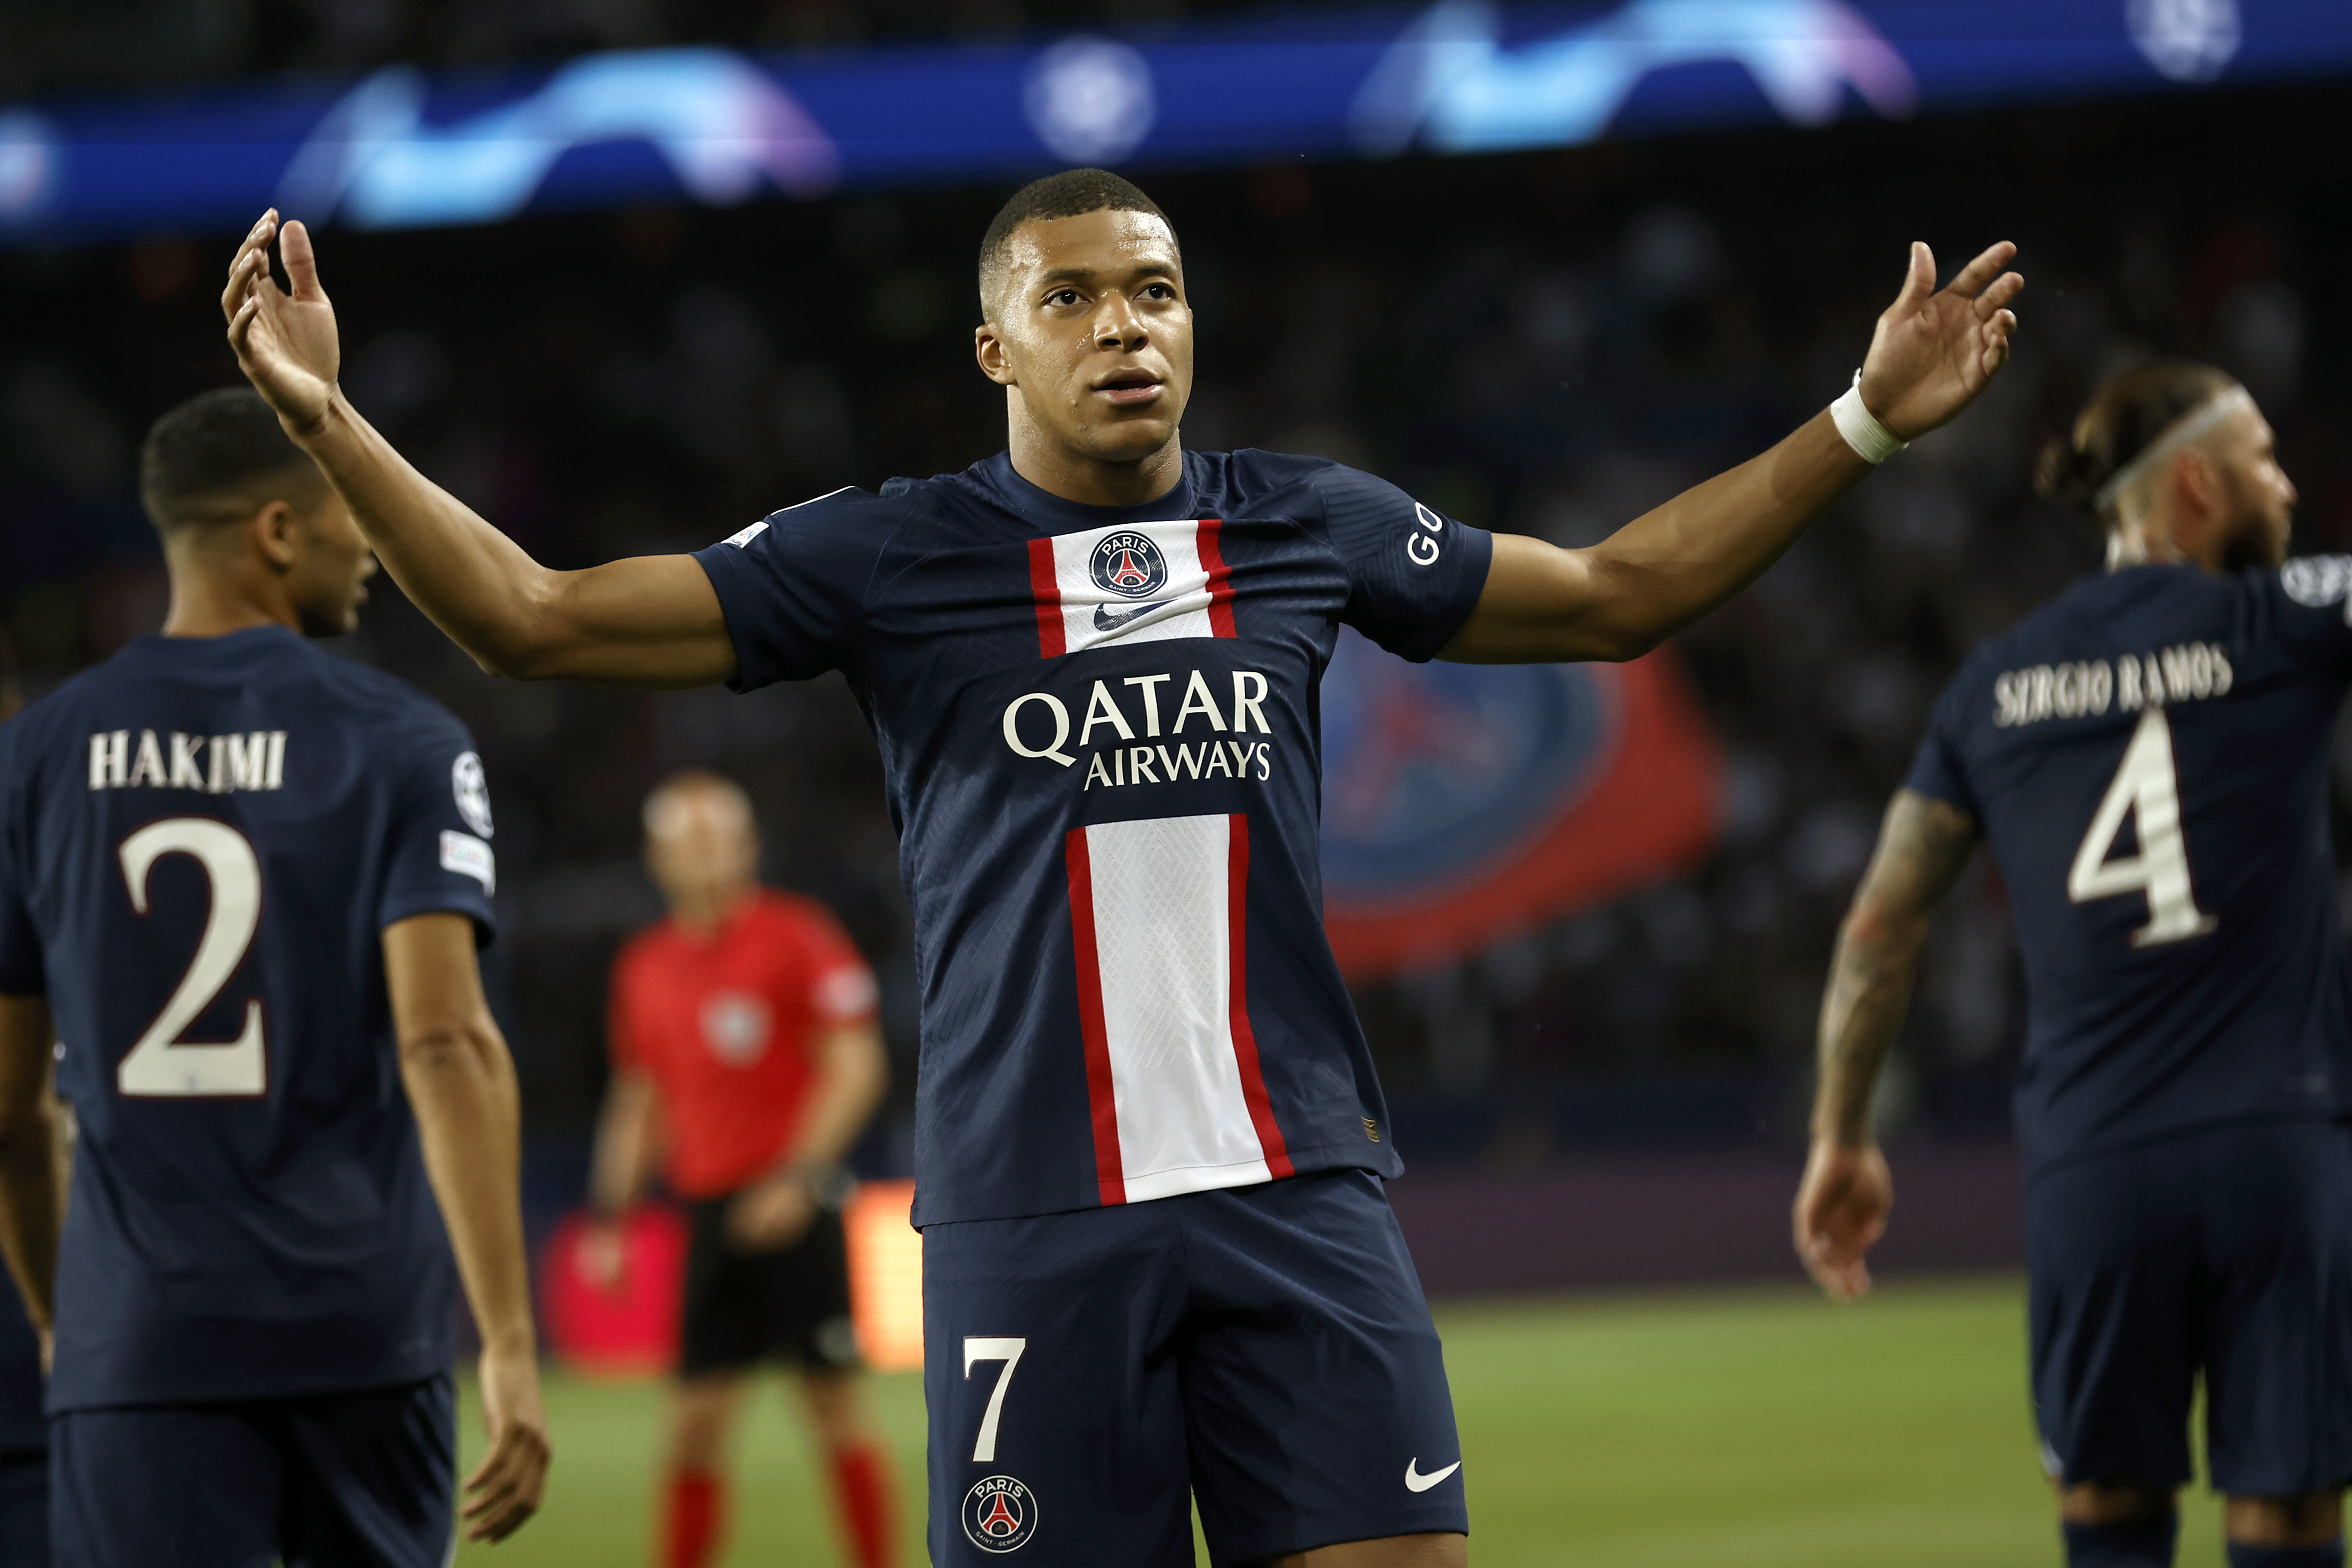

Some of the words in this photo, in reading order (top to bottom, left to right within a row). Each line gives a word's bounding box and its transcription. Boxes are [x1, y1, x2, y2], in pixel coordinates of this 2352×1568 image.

[1101, 536, 1149, 556] PARIS
[1133, 581, 1156, 592] GERMAIN
[2118, 641, 2233, 711] RAMOS
[1003, 669, 1272, 767] QATAR
[89, 729, 288, 793] HAKIMI
[1084, 740, 1271, 791] AIRWAYS
[2068, 706, 2219, 947] 4
[118, 816, 266, 1096] 2
[964, 1337, 1026, 1462] 7
[974, 1479, 1025, 1498] PARIS
[975, 1531, 993, 1545] SAINT
[998, 1530, 1025, 1547] GERMAIN
